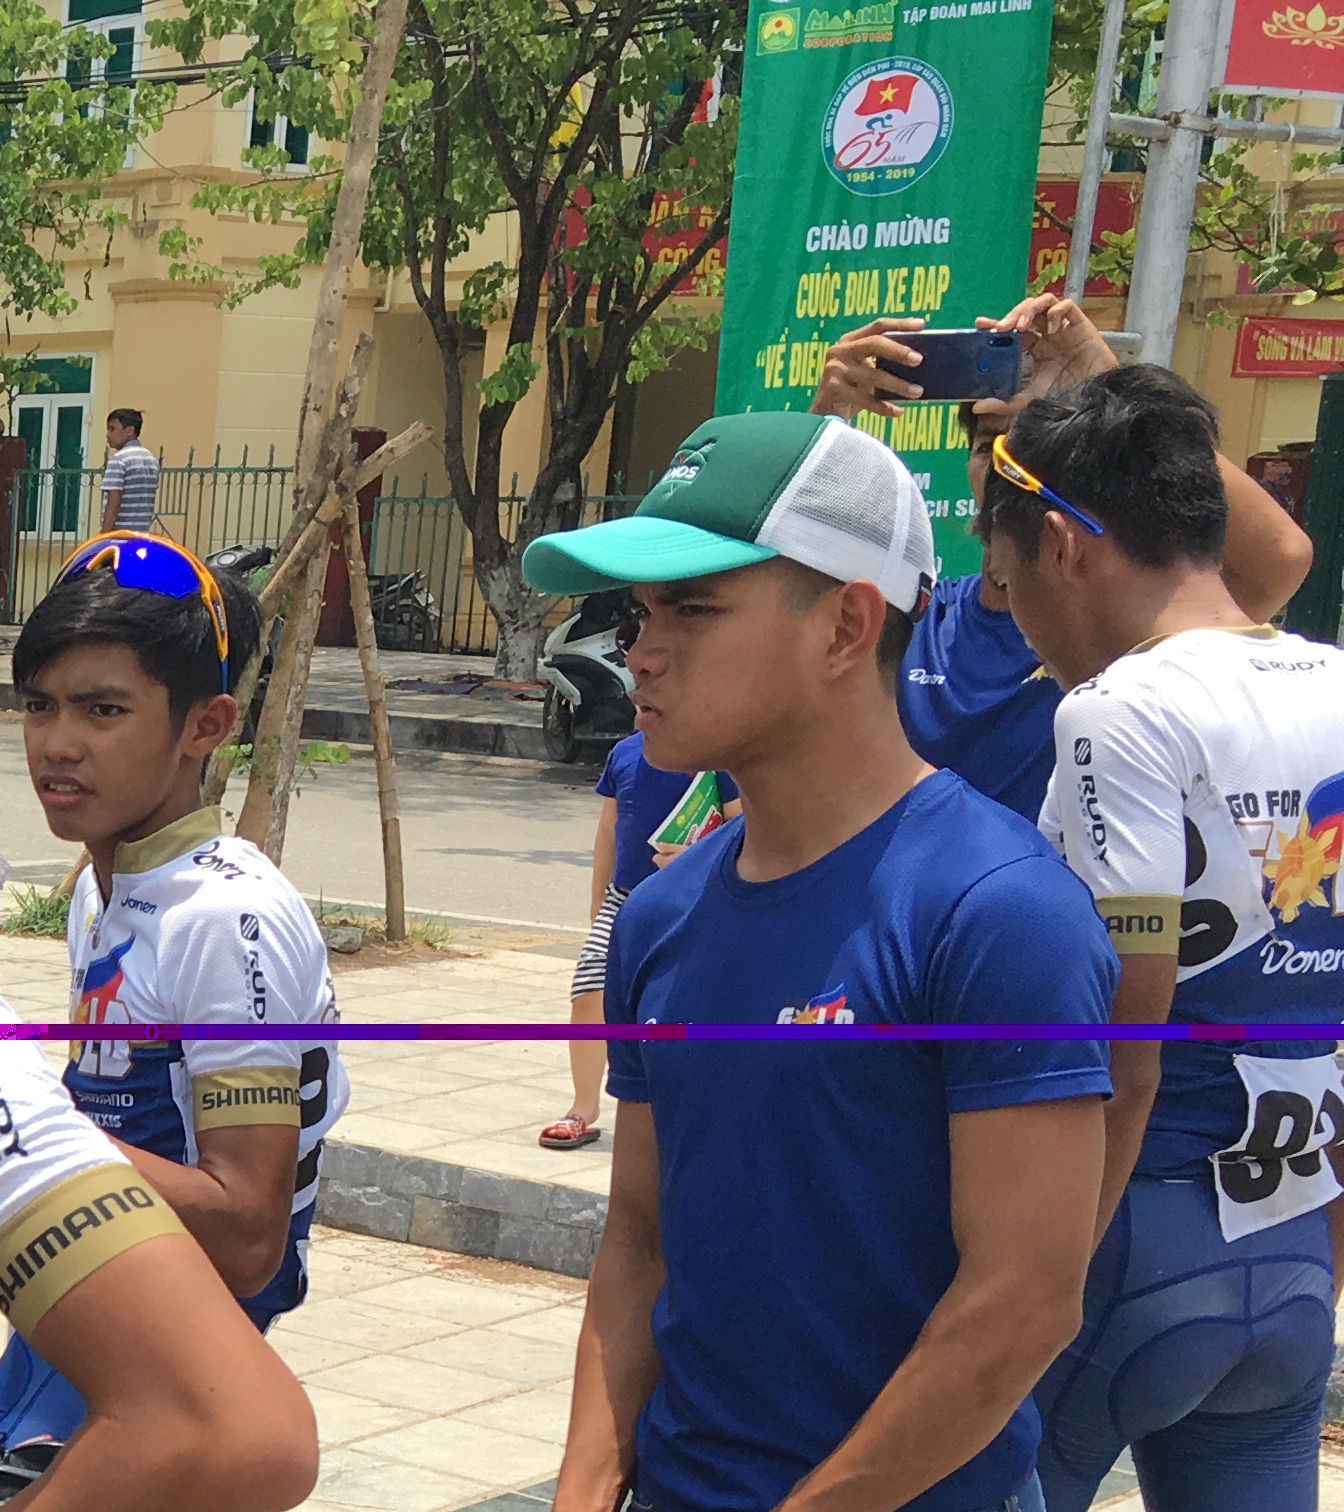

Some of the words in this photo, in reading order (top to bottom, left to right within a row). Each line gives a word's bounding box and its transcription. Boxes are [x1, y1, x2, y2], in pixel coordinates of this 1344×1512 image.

[970, 0, 996, 16] MAI
[803, 30, 894, 48] CORPORATION
[846, 170, 875, 183] 1954
[885, 167, 916, 180] 2019
[805, 219, 869, 253] CHÀO
[874, 213, 952, 249] MỪNG
[796, 262, 841, 328] CUỘC
[844, 268, 880, 317] ĐUA
[882, 267, 909, 314] XE
[910, 264, 951, 322] ĐẠP
[1227, 791, 1261, 819] GO
[1266, 788, 1302, 818] FOR
[1081, 774, 1111, 868] RUDY
[248, 949, 269, 1025] RUD
[201, 1086, 301, 1111] SHIMANO
